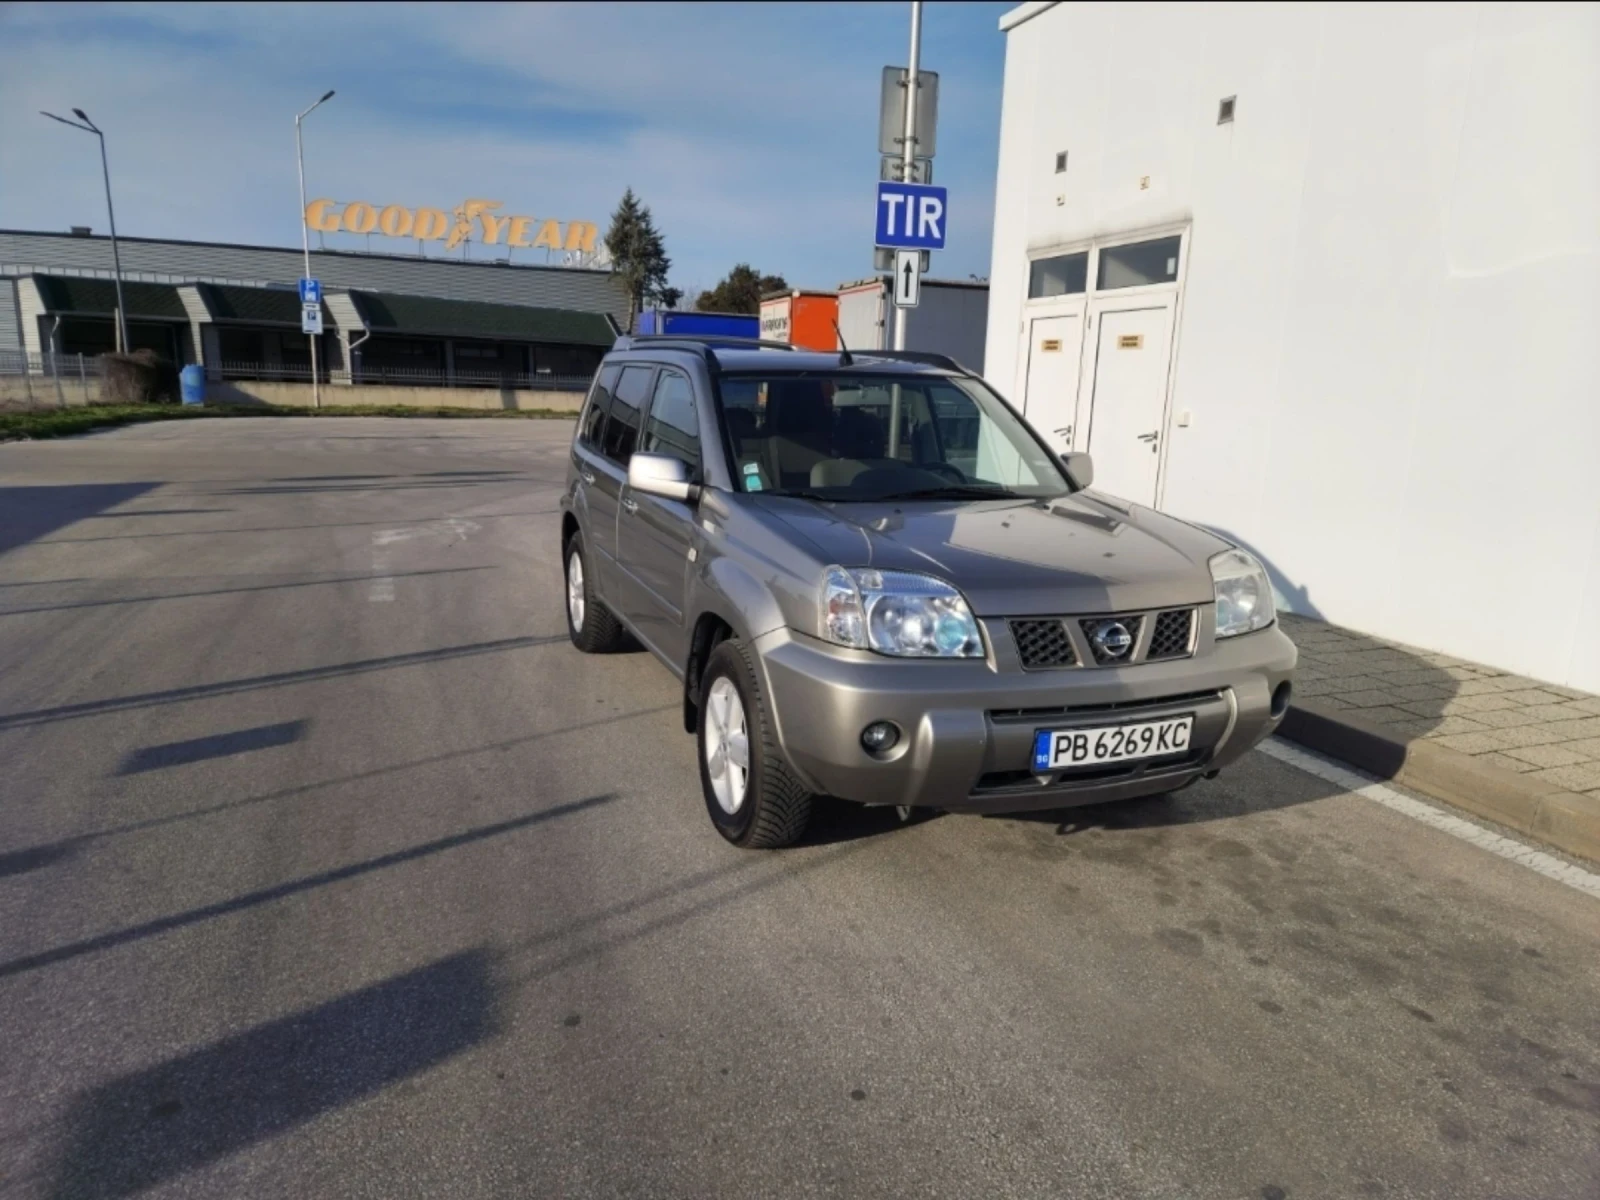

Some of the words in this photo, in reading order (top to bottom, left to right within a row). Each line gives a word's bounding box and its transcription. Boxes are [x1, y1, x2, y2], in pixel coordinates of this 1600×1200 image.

[881, 193, 943, 239] TIR
[1053, 734, 1088, 763] PB
[1094, 727, 1154, 759] 6269
[1157, 721, 1188, 752] KC
